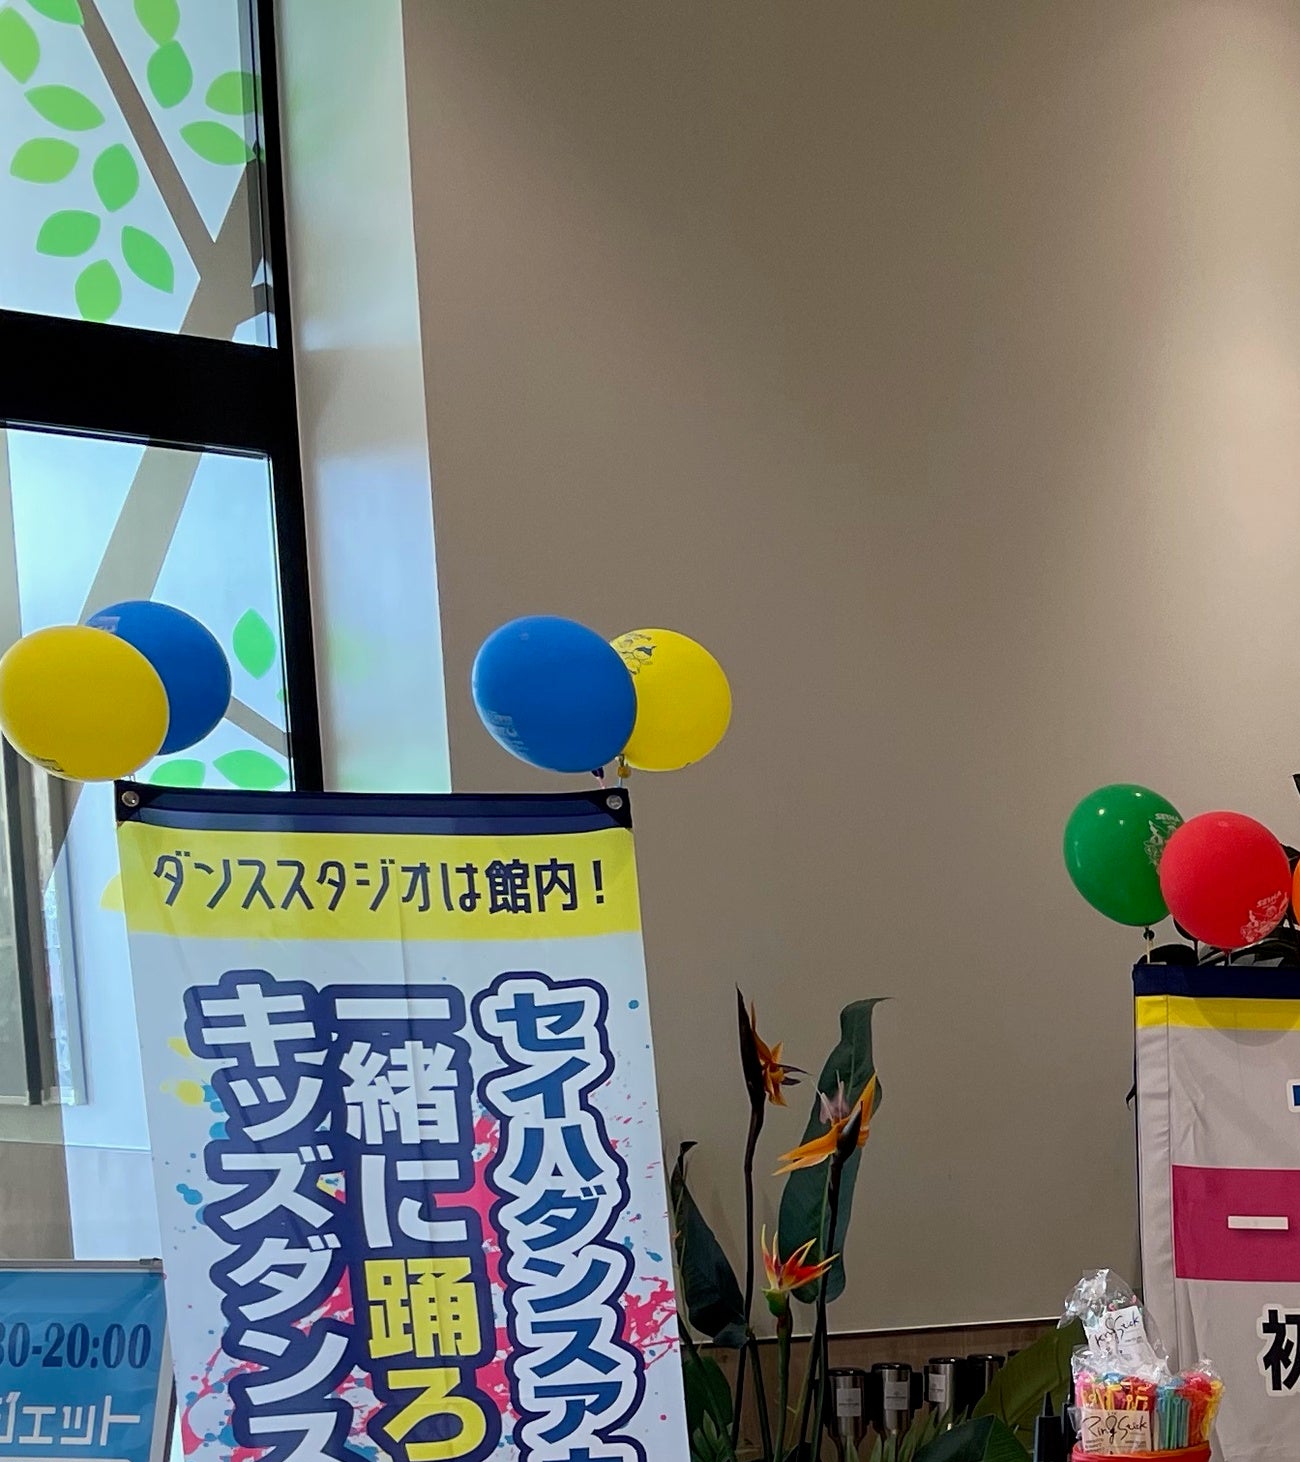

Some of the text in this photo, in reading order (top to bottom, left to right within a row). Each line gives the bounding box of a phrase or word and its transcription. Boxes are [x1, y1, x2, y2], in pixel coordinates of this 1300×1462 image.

[153, 848, 606, 914] ダンススタジオは館内！
[0, 1322, 151, 1369] 0-20:00
